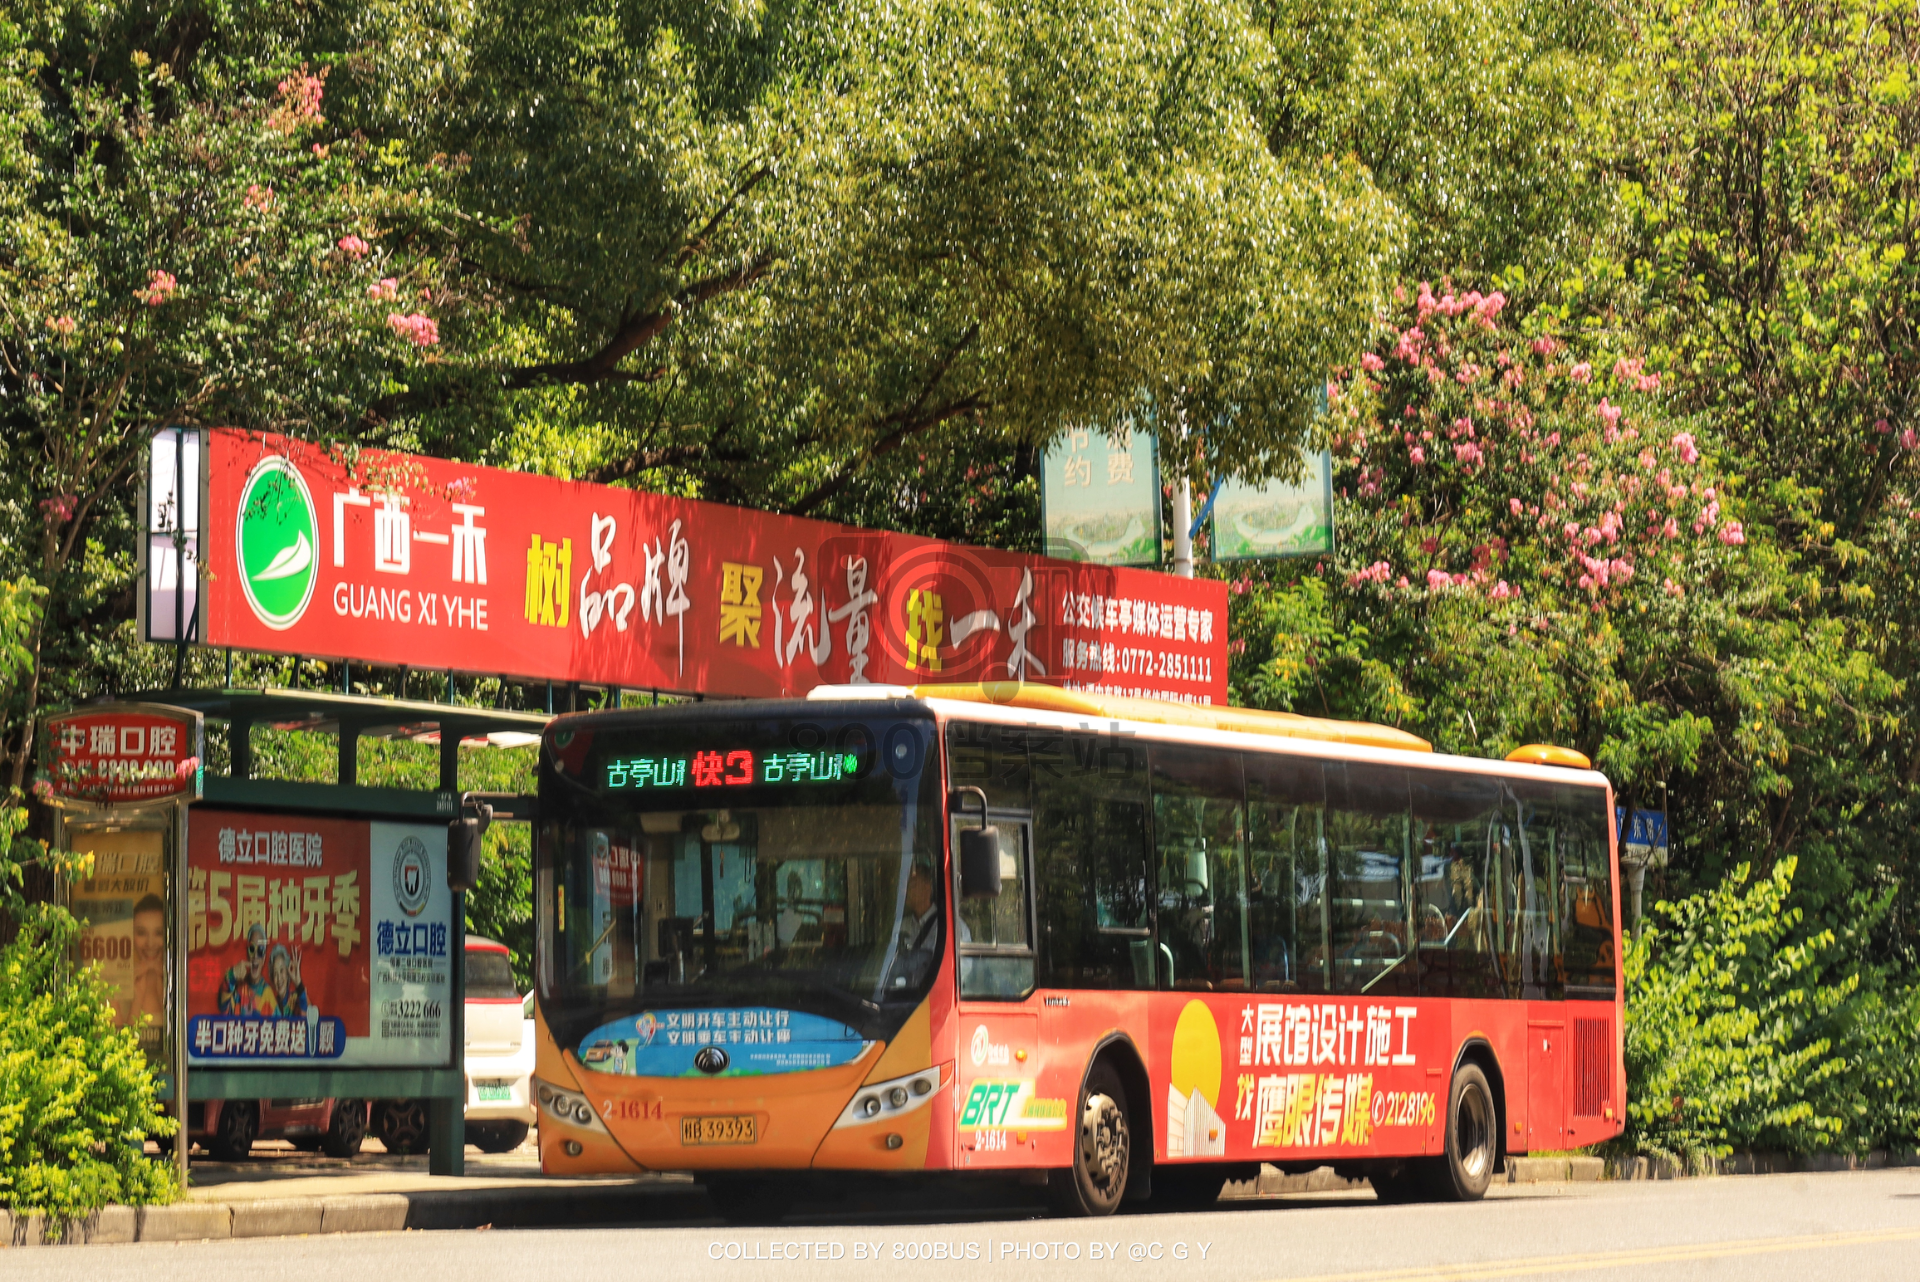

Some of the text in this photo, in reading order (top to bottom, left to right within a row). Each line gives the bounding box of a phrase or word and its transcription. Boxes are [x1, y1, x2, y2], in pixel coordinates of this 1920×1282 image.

[332, 487, 488, 586] 广西一禾
[332, 582, 489, 631] GUANG XI YHE
[525, 510, 1047, 684] 树品牌 聚流量 找一禾
[1062, 589, 1214, 645] 公交候车亭媒体运营专家
[60, 724, 177, 757] 中瑞口腔
[692, 750, 754, 787] 快3
[218, 826, 324, 868] 德立口腔医院
[188, 865, 361, 958] 第5届种牙季
[79, 935, 132, 961] 6600
[377, 919, 447, 957] 德立口腔
[397, 1000, 421, 1019] 3222
[423, 1001, 441, 1019] 666
[666, 1010, 791, 1029] 文明开车主动让行
[667, 1028, 792, 1045] 文明乘车主动让座
[1239, 1003, 1418, 1067] 大型 展馆设计施工
[603, 1099, 663, 1121] 2-1614
[960, 1083, 1021, 1126] BRT
[1384, 1091, 1436, 1127] 2128196
[974, 1129, 1007, 1151] 2-1614
